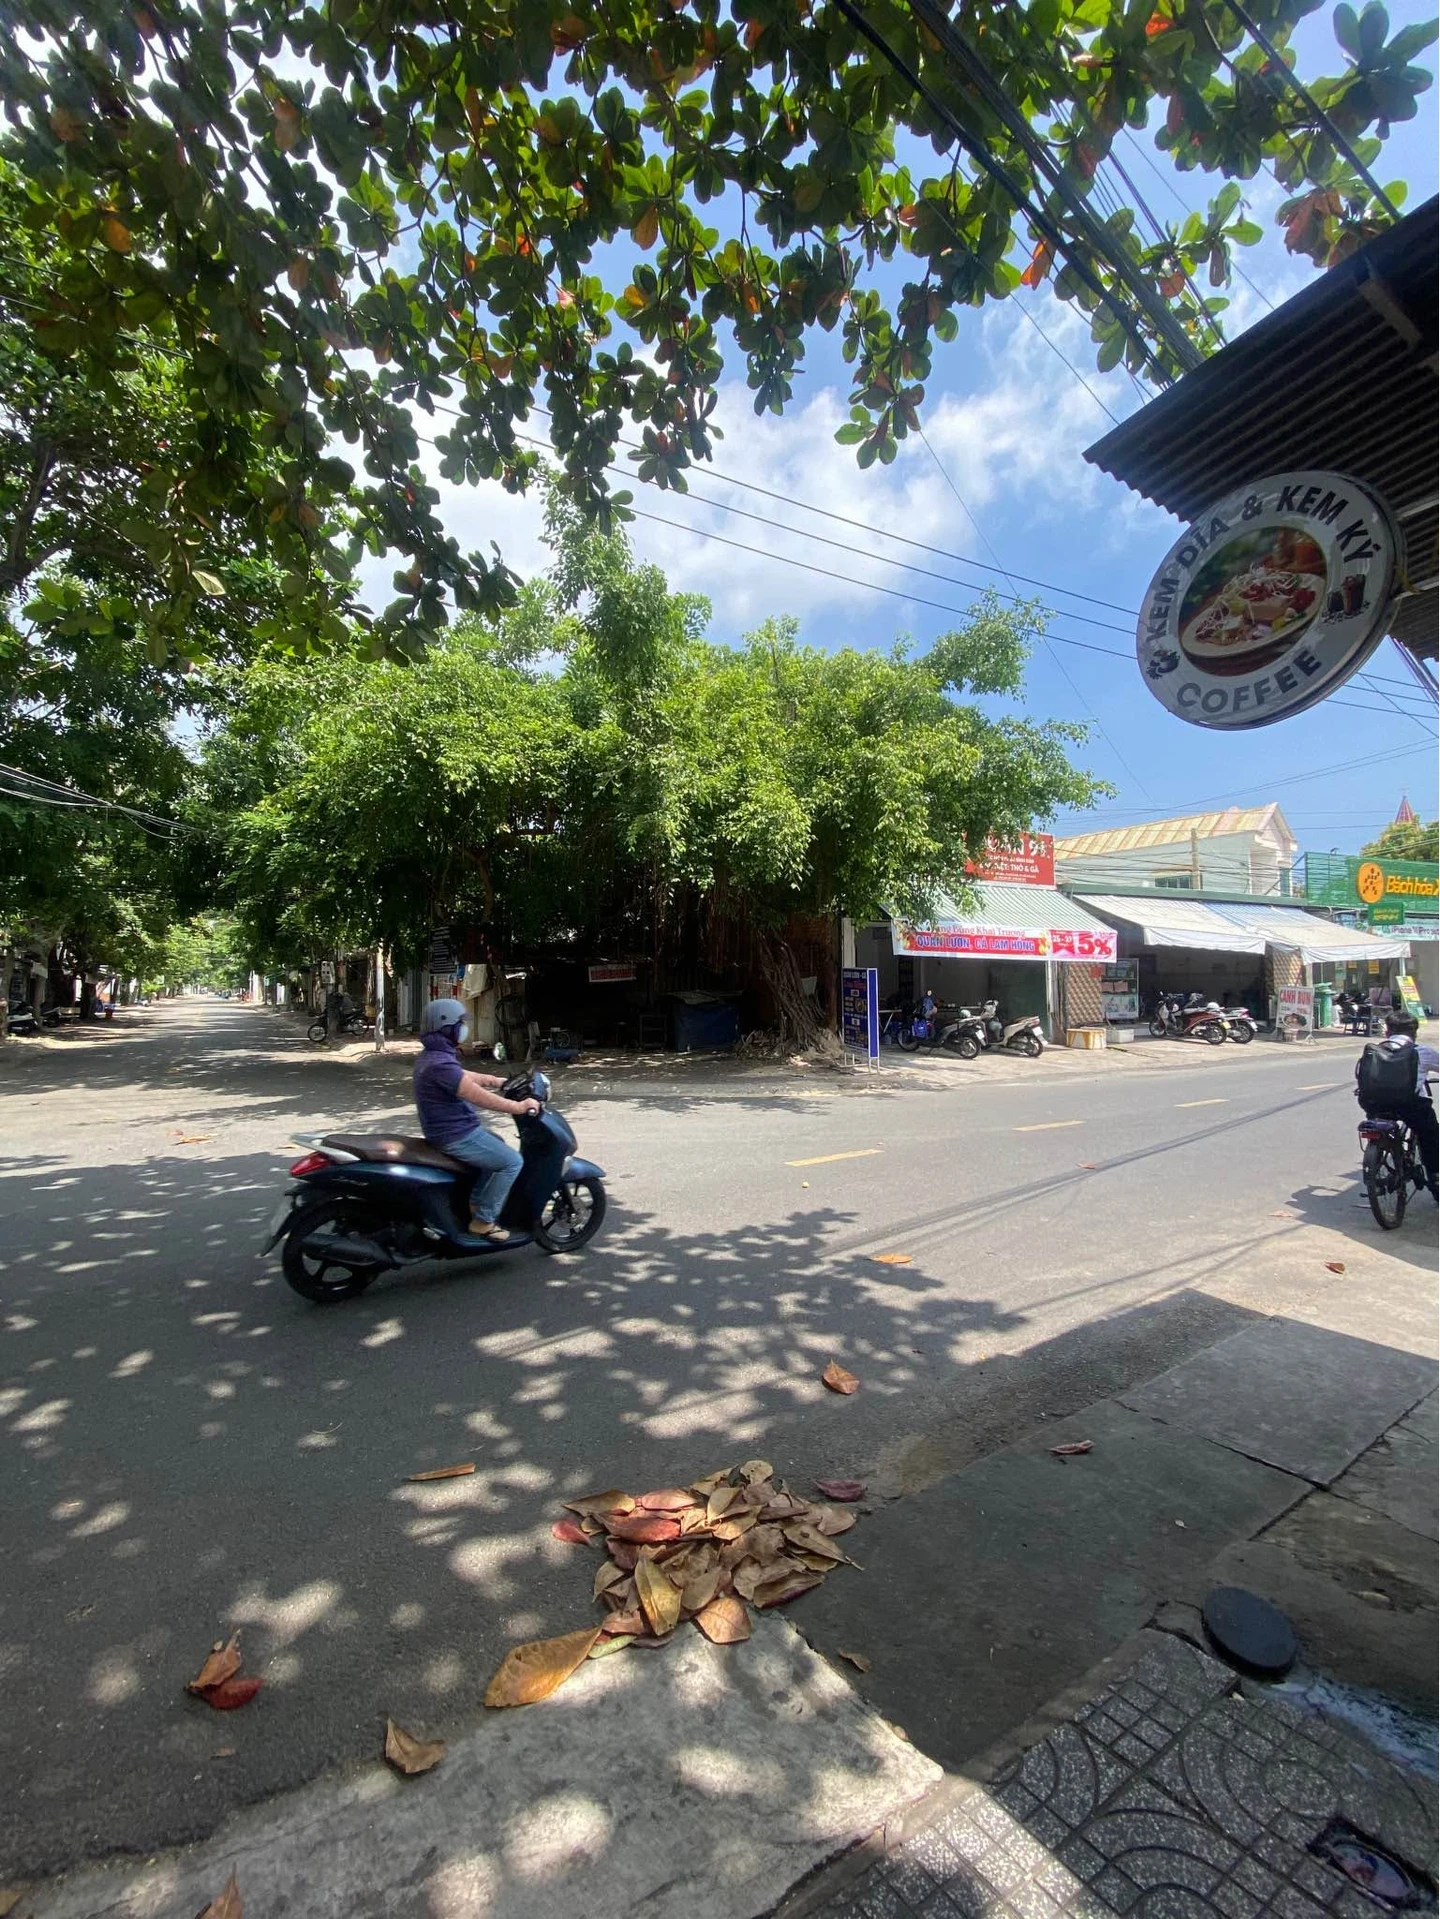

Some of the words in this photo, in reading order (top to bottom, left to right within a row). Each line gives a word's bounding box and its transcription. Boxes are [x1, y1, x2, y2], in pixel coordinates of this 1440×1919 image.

[1146, 578, 1180, 642] KEM
[1242, 495, 1264, 521] &
[1276, 485, 1349, 526] KEM
[1176, 650, 1322, 713] COFFEE
[1078, 932, 1112, 956] 5%
